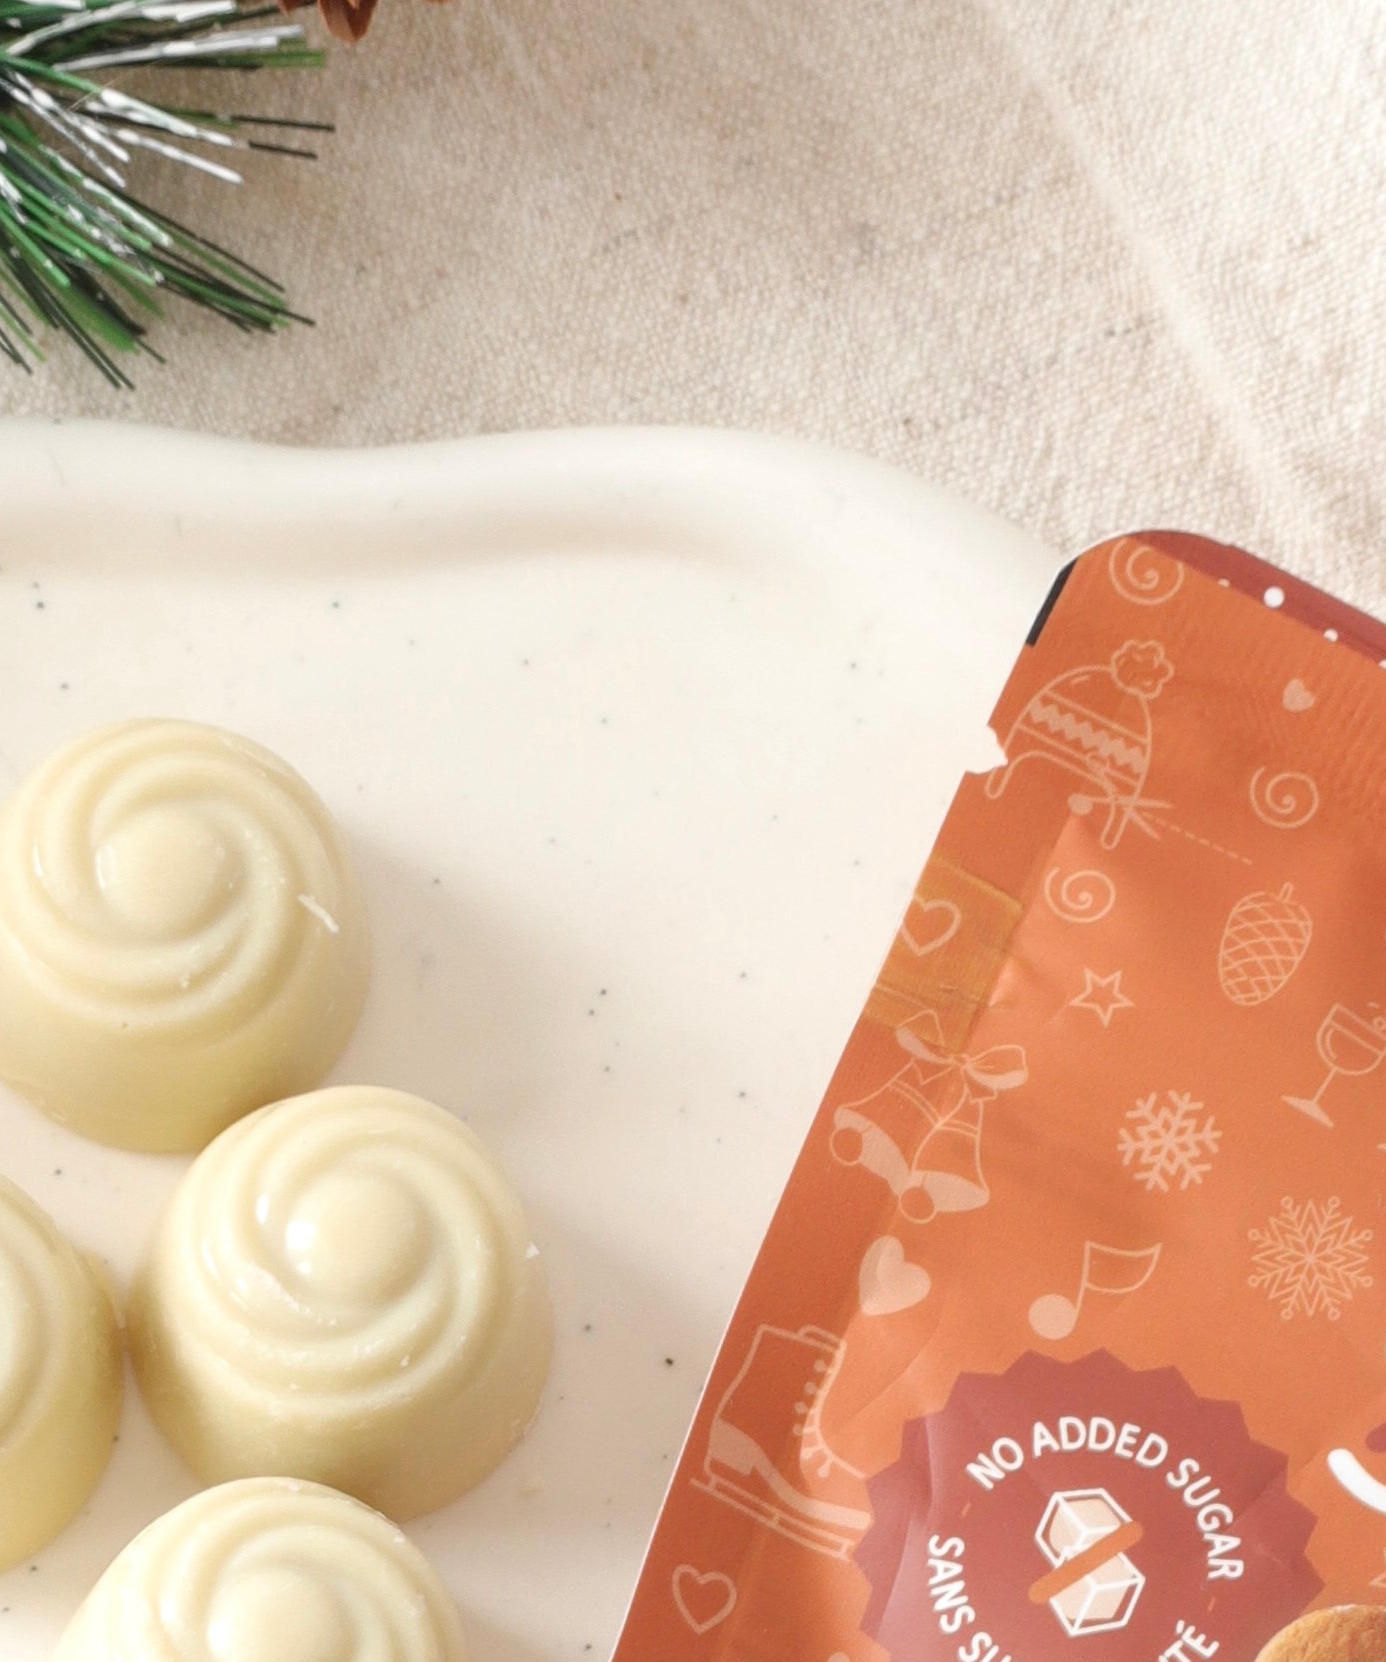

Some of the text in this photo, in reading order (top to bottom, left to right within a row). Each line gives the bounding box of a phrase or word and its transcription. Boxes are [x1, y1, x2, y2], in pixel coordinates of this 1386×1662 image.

[965, 1415, 1245, 1582] NO ADDED SUGAR
[927, 1533, 976, 1636] SANS
